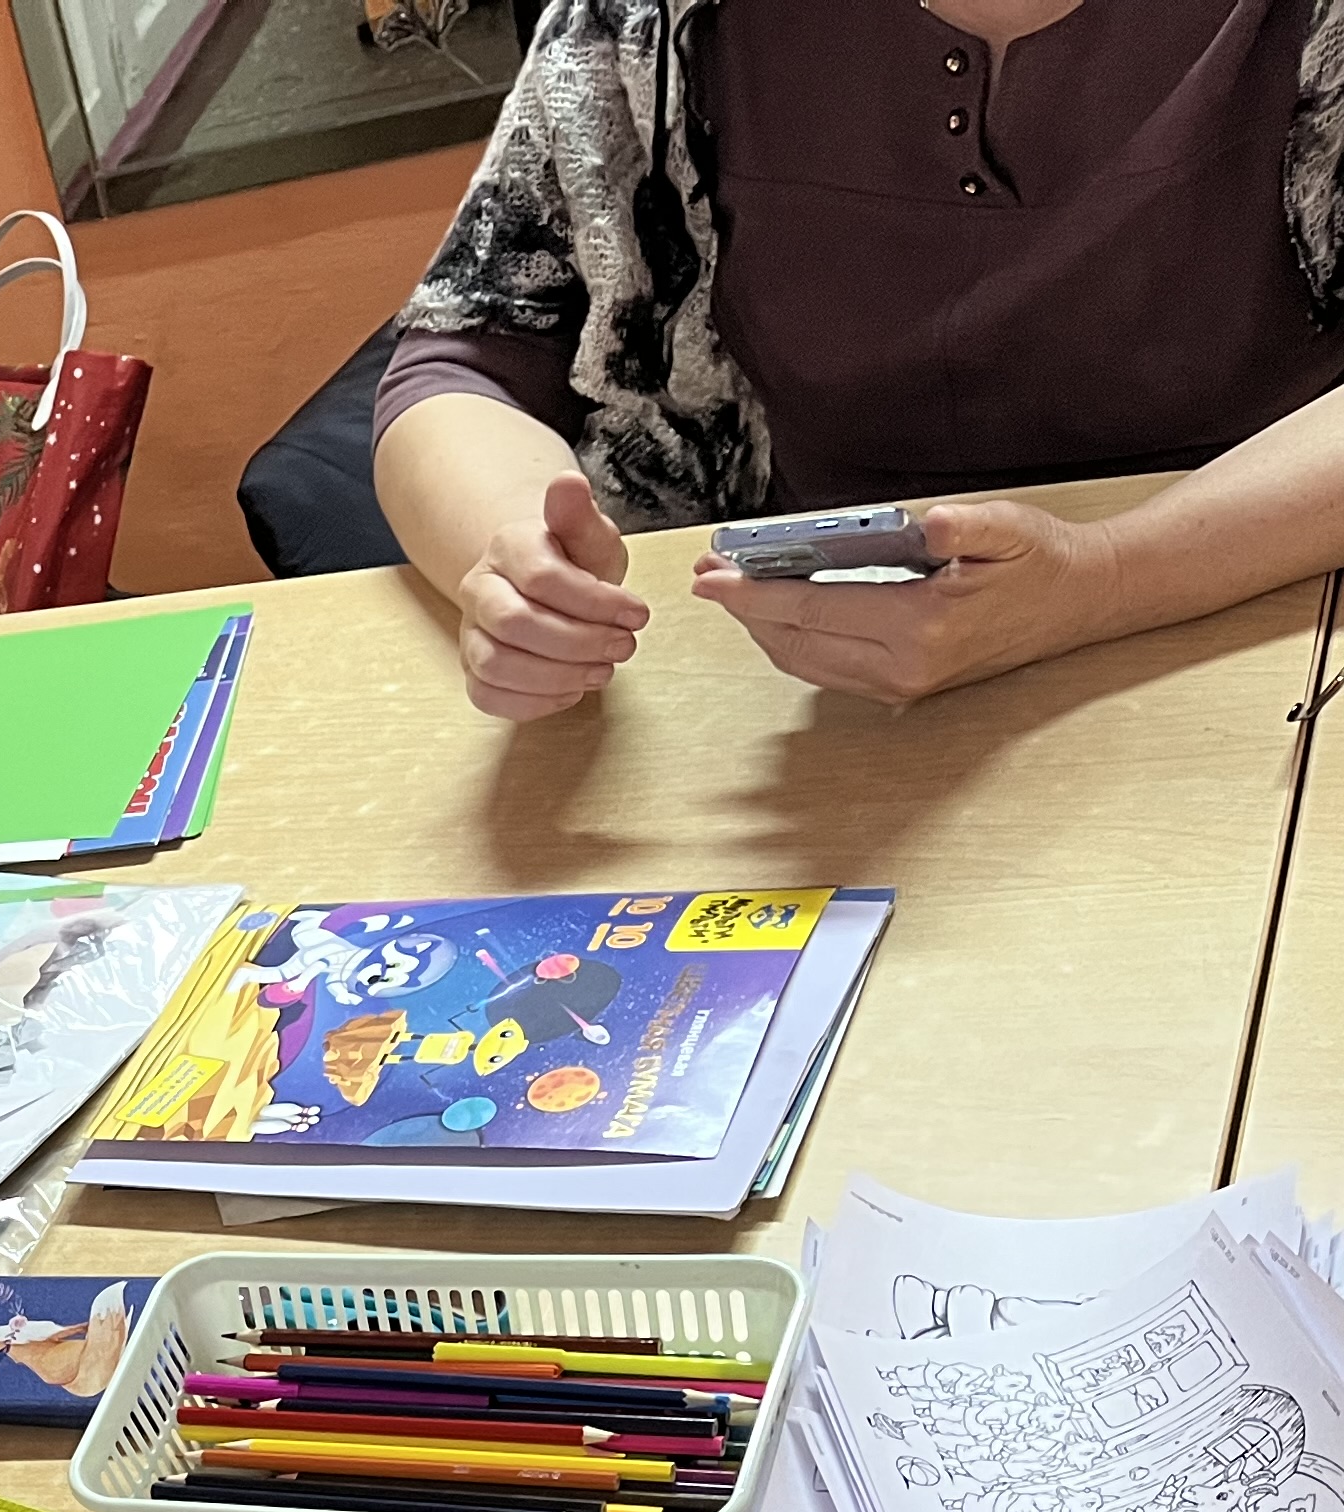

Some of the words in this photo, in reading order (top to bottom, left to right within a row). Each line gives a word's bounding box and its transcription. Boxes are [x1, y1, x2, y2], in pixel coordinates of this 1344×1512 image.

[627, 896, 673, 914] 10
[606, 922, 653, 948] 10
[603, 1056, 662, 1138] БУМАГА
